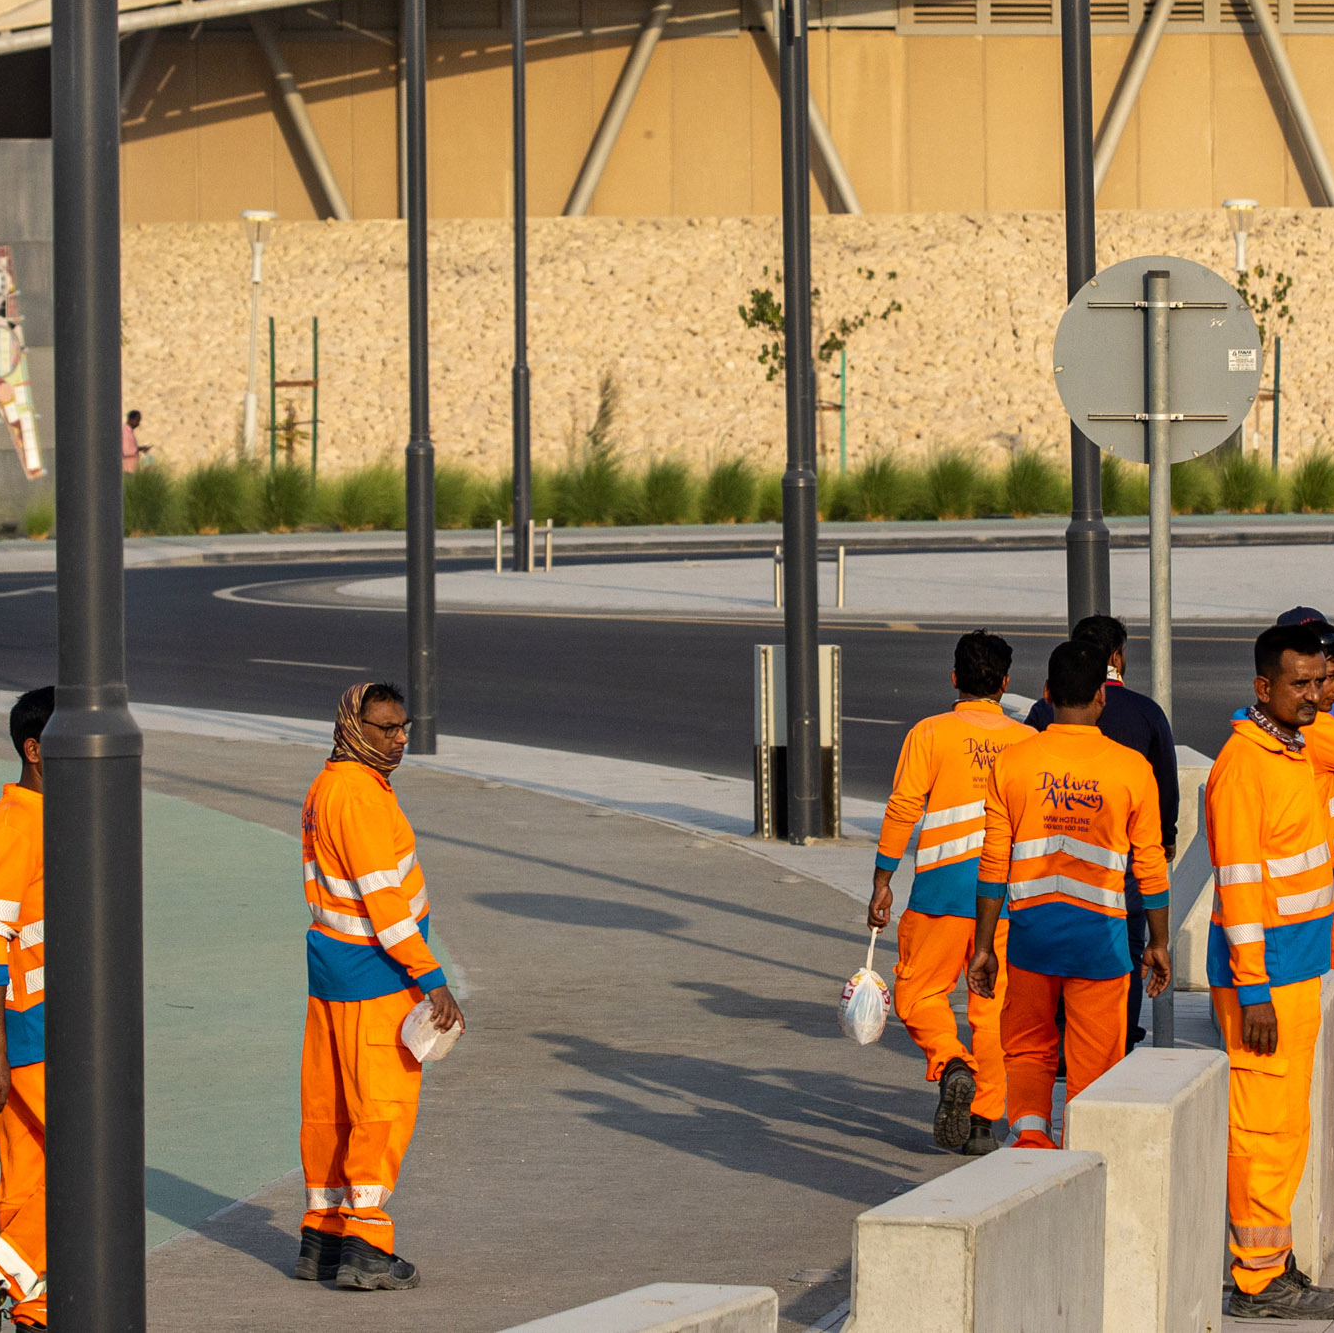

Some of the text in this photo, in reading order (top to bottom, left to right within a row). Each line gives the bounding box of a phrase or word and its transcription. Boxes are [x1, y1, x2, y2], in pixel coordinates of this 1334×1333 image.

[962, 737, 1013, 755] Delive
[1035, 771, 1100, 793] Deliver
[1059, 817, 1090, 826] HOTLINE
